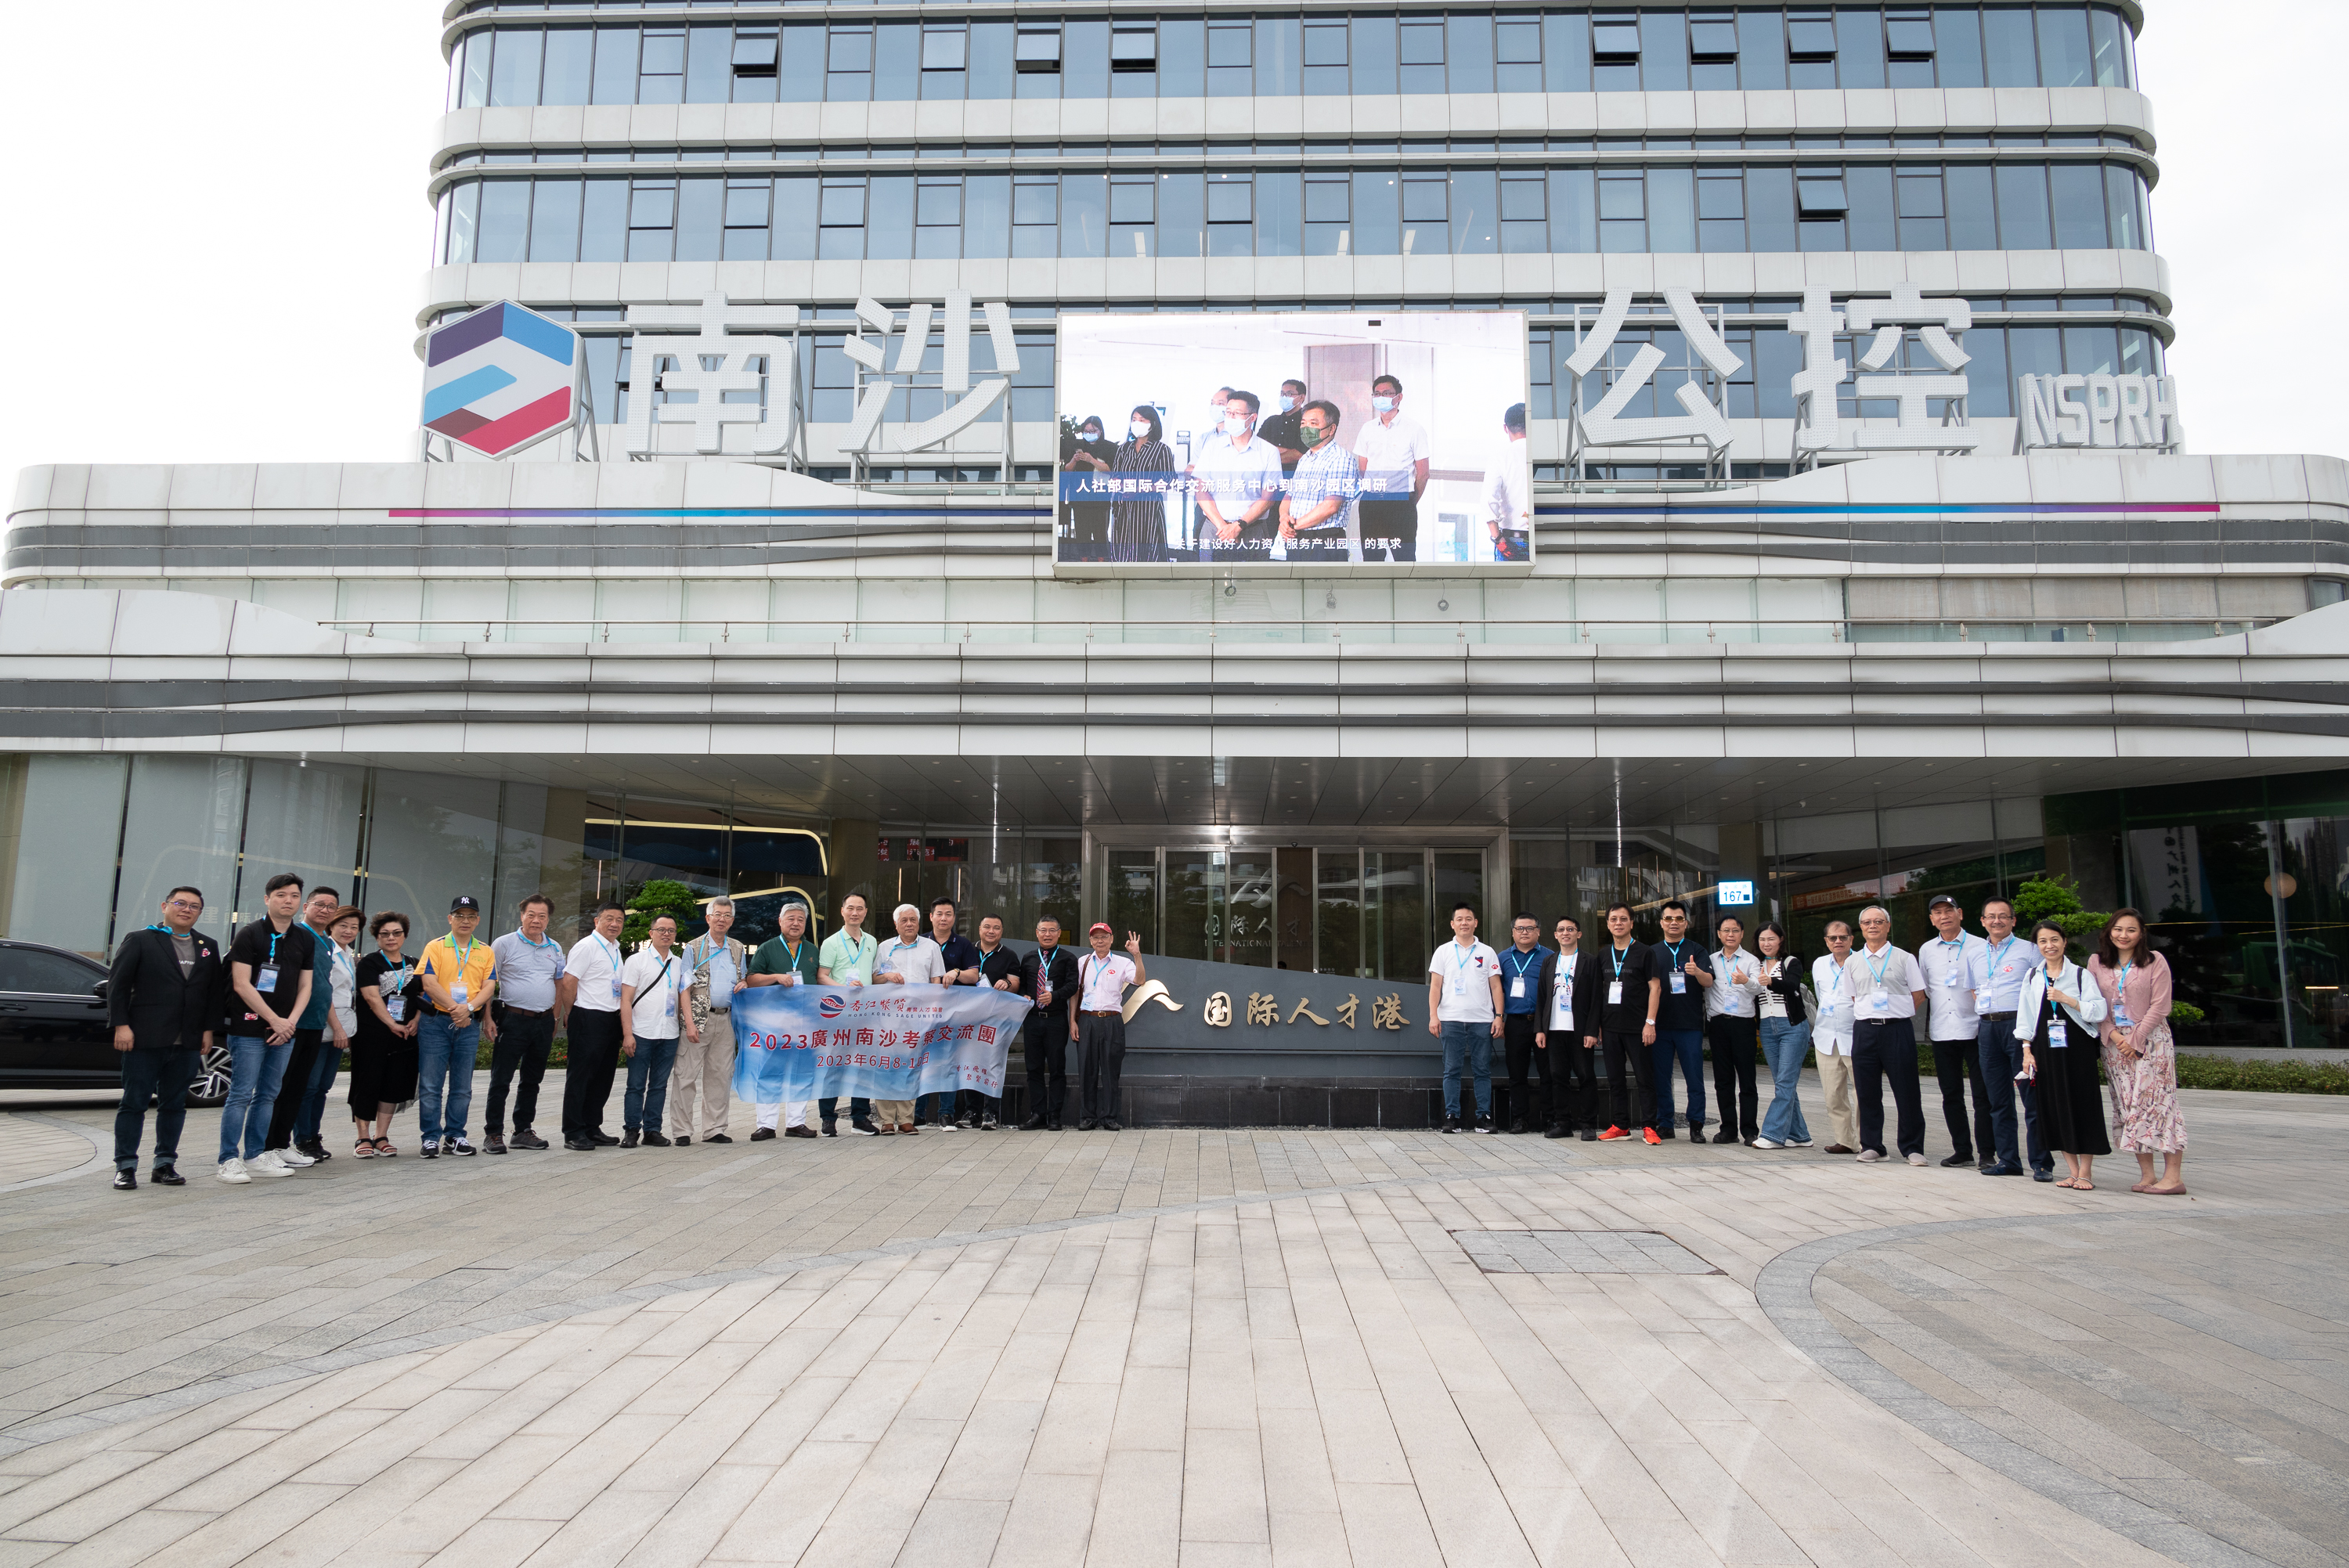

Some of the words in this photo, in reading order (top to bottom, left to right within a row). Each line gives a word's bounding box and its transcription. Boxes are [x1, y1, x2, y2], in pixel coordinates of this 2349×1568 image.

[626, 288, 1020, 456] 南沙
[1563, 282, 1979, 451] 公控
[2020, 373, 2181, 448] NSPRH
[1076, 478, 1387, 493] 人社部国际合作交流服务中心到南沙园区调研
[1364, 538, 1402, 550] 的要求
[1723, 891, 1741, 902] 167
[824, 999, 837, 1007] HKSU
[1204, 991, 1410, 1030] 国际人才港
[749, 1024, 997, 1051] 2023廣州南沙考察交流團
[817, 1051, 930, 1069] 2023年6月8-10日
